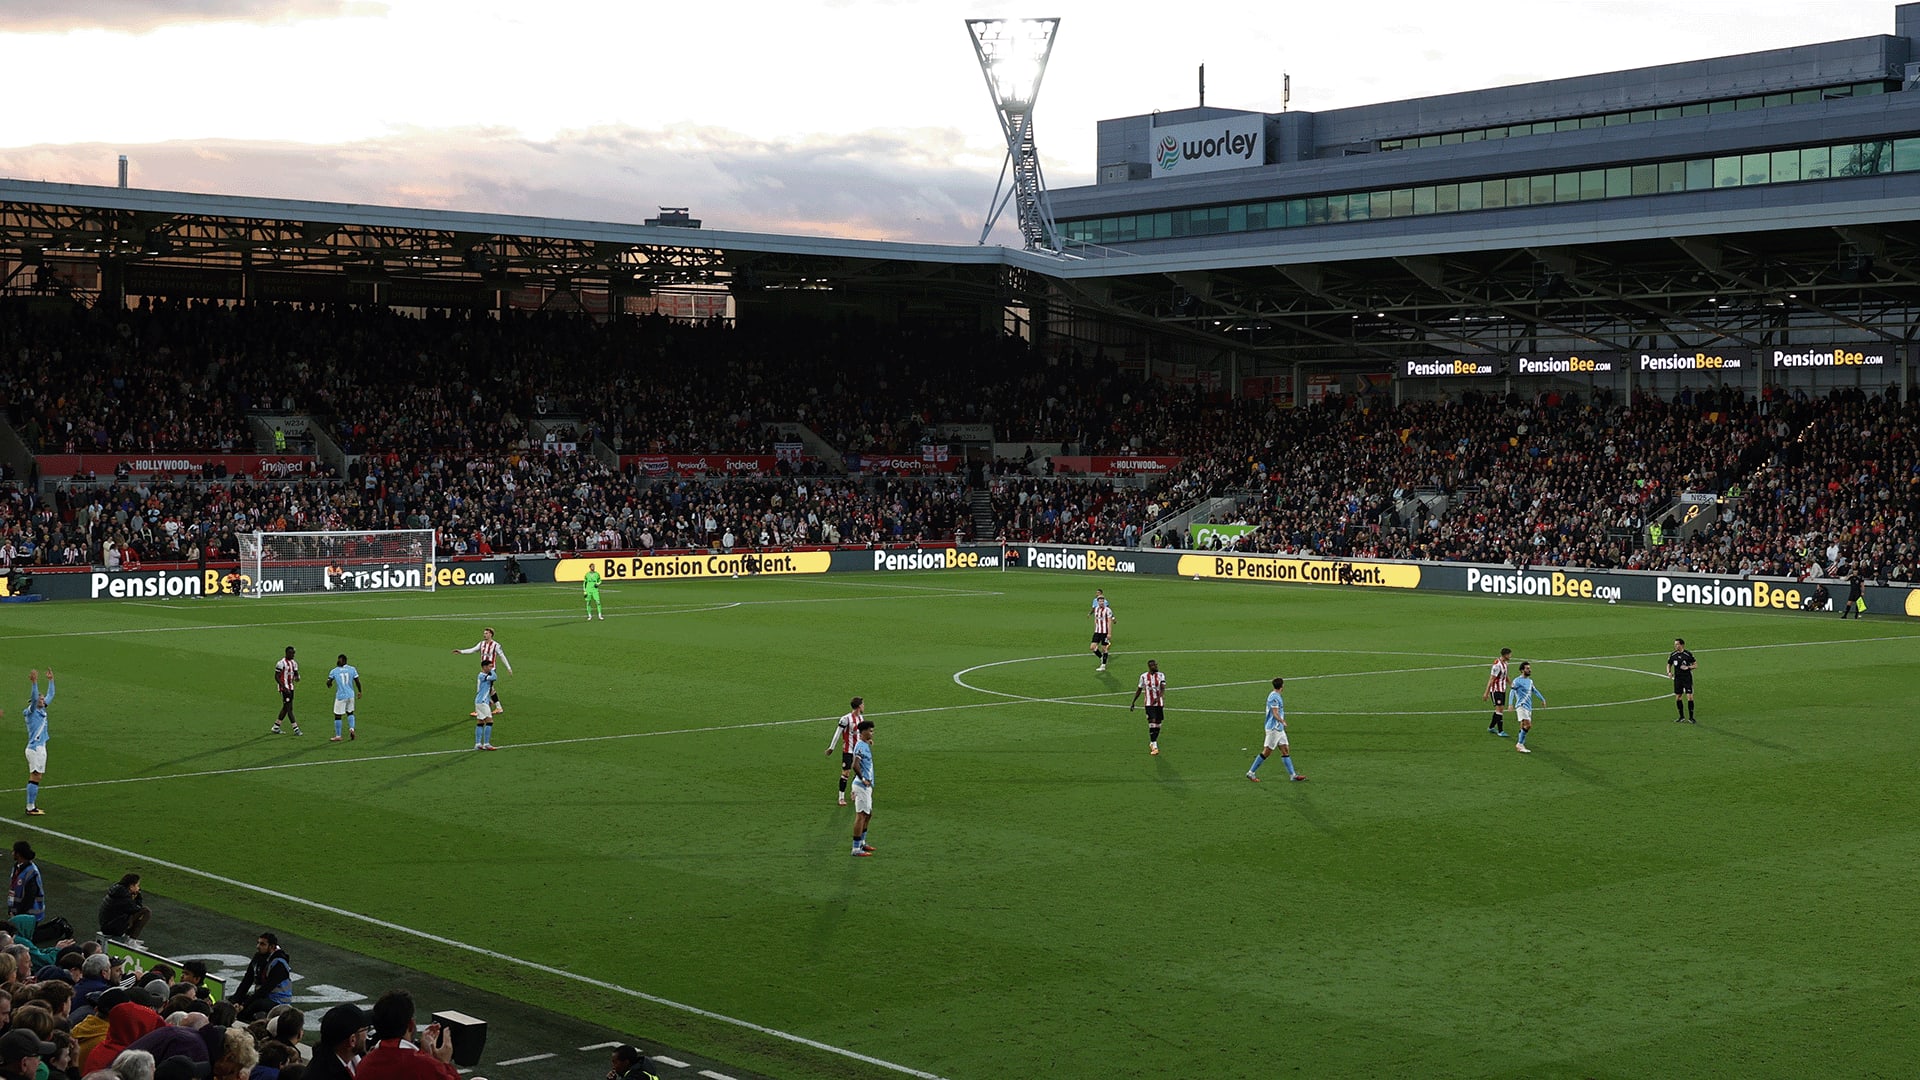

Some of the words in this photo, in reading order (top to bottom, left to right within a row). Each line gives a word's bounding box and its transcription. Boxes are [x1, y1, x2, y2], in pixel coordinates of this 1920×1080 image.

[1183, 130, 1258, 160] worley
[261, 459, 303, 472] ined
[726, 459, 758, 470] indeed
[604, 559, 627, 577] Be
[632, 557, 702, 577] Pension
[707, 554, 797, 575] Confdent.
[1215, 557, 1233, 576] Be
[1238, 558, 1297, 580] Pension
[1301, 561, 1386, 585] Confient.
[1656, 577, 1833, 612] PensionBee.CM
[340, 672, 350, 685] 11
